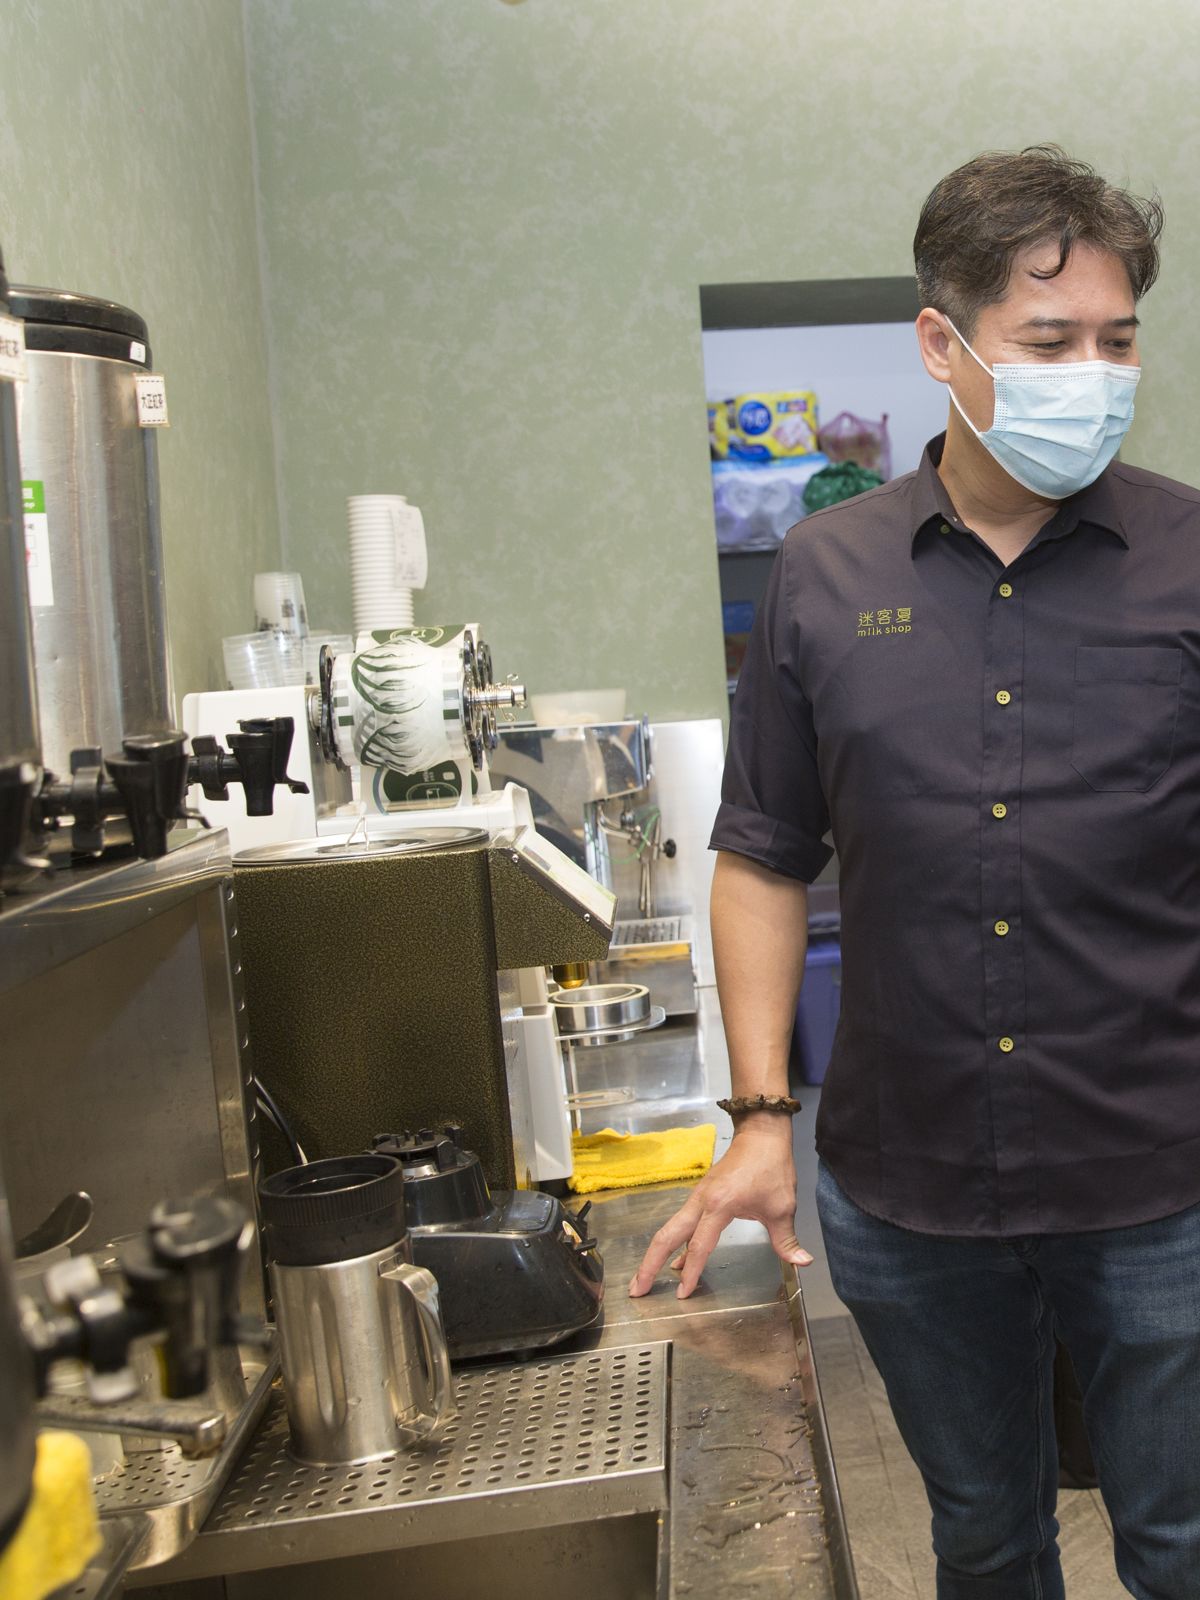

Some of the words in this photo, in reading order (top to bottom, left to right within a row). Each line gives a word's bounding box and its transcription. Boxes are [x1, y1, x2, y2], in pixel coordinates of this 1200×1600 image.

[857, 607, 912, 627] 迷客夏
[857, 626, 882, 637] milk
[885, 624, 912, 634] shop
